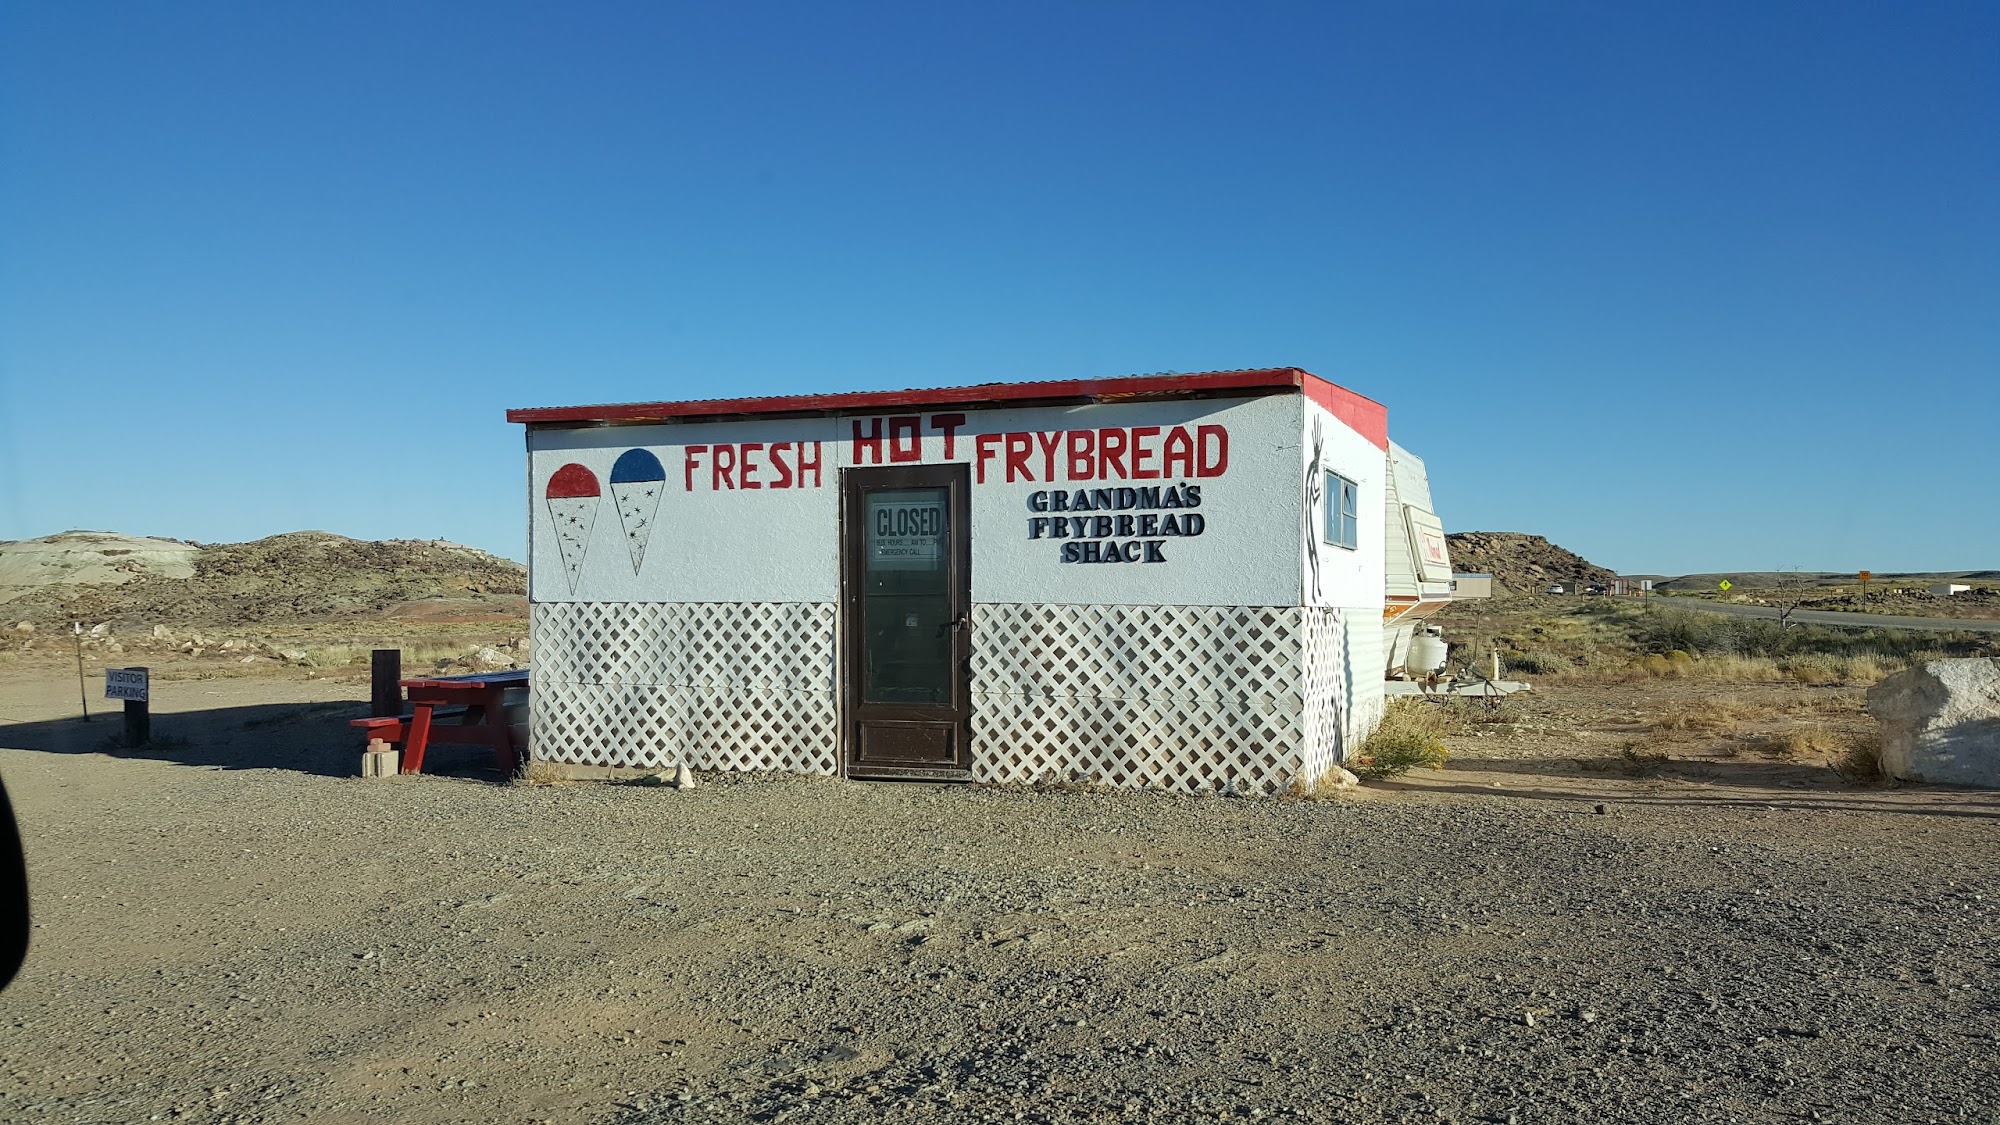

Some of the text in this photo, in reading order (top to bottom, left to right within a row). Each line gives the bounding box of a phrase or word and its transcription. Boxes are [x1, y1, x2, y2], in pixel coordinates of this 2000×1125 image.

[685, 413, 1228, 491] FRESH HOT FRYBREAD
[877, 508, 940, 536] CLOSED
[1028, 513, 1206, 539] FRYBREAD
[920, 538, 926, 546] TO
[1060, 540, 1167, 564] SHACK
[109, 671, 143, 684] VISITOR
[106, 685, 147, 699] PARKING
